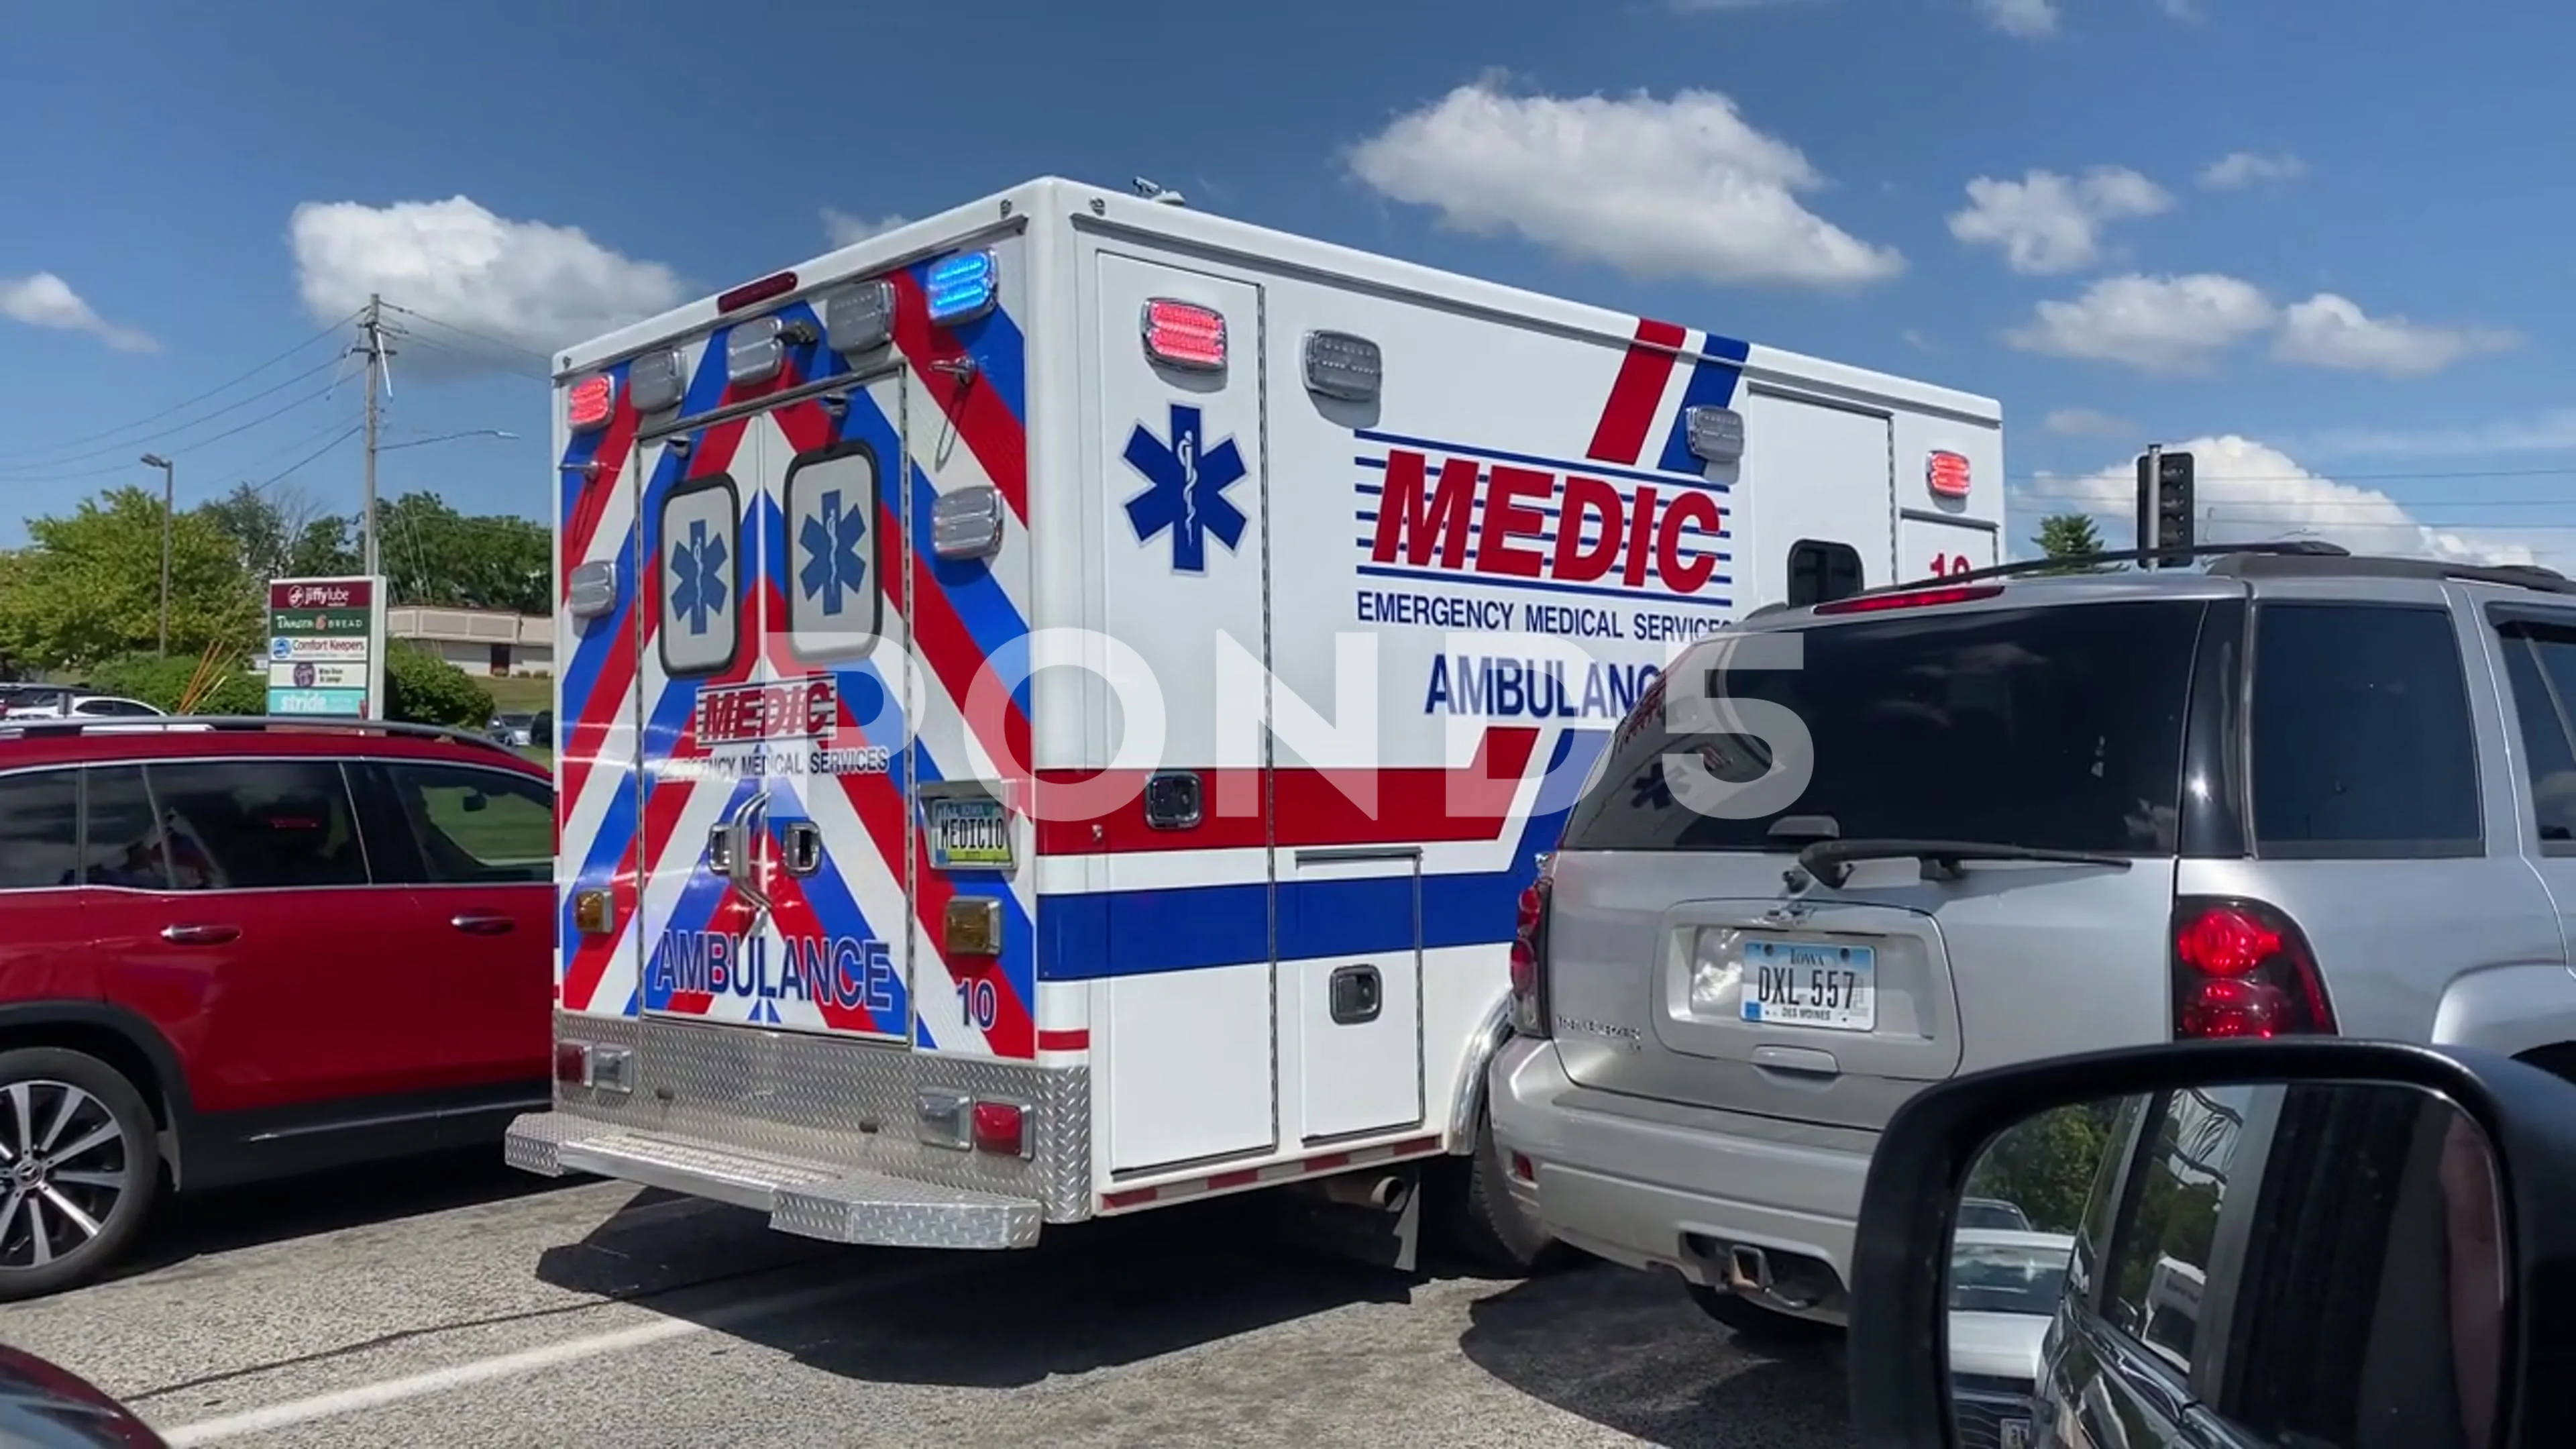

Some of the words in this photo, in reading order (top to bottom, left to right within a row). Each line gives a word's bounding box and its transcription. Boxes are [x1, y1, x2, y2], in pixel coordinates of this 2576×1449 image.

[1373, 448, 1721, 594] MEDIC
[327, 619, 363, 629] BREAD
[1357, 591, 1515, 631] EMERGENCY
[1525, 604, 1624, 638] MEDICAL
[293, 639, 328, 651] Comfort
[329, 640, 365, 651] Keepers
[280, 691, 327, 712] stride
[705, 682, 830, 739] MEDIC
[741, 751, 804, 775] MEDICAL
[810, 747, 889, 774] SERVICES
[941, 818, 1004, 850] MEDIC10
[654, 930, 894, 1011] AMBULANCE
[1758, 966, 1801, 1006] DXL
[1811, 969, 1856, 1010] 557
[957, 979, 997, 1030] 10
[1782, 1007, 1798, 1019] DES
[1800, 1009, 1832, 1021] MOINES
